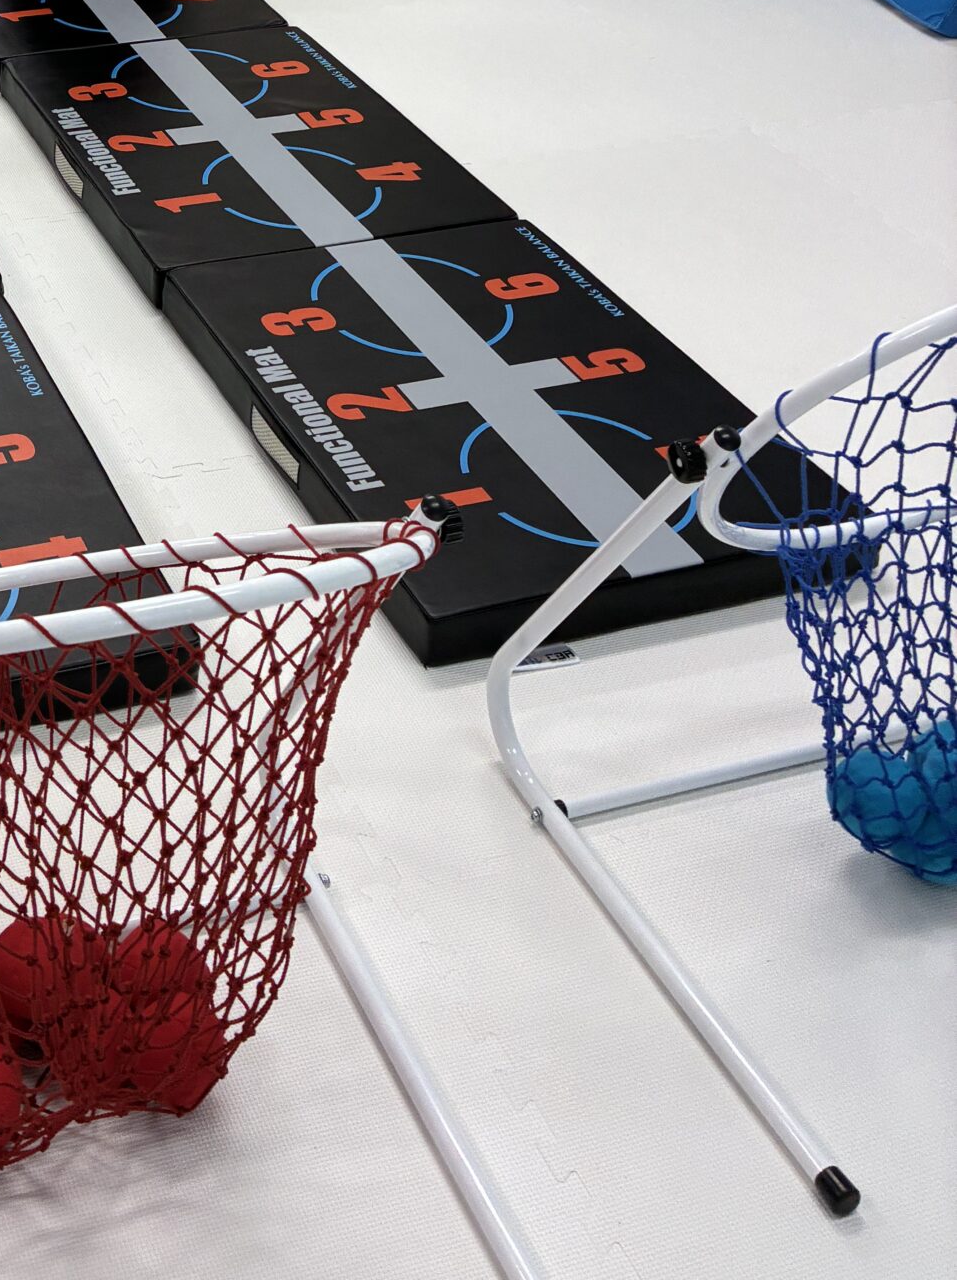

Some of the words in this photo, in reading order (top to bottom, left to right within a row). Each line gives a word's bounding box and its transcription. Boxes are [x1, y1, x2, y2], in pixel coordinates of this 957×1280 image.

[250, 60, 310, 78] 6
[67, 82, 128, 101] 3
[51, 106, 88, 130] Mat
[297, 108, 364, 129] 5
[108, 130, 175, 152] 2
[67, 129, 142, 196] Functional
[355, 161, 422, 181] 4
[154, 192, 222, 214] 1
[515, 226, 559, 259] BALANCE
[485, 272, 560, 300] 6
[554, 260, 592, 289] TAIKAN
[260, 307, 337, 336] 3
[244, 345, 297, 383] Mat
[561, 348, 646, 381] 5
[326, 386, 413, 420] 2
[271, 383, 386, 492] Functional
